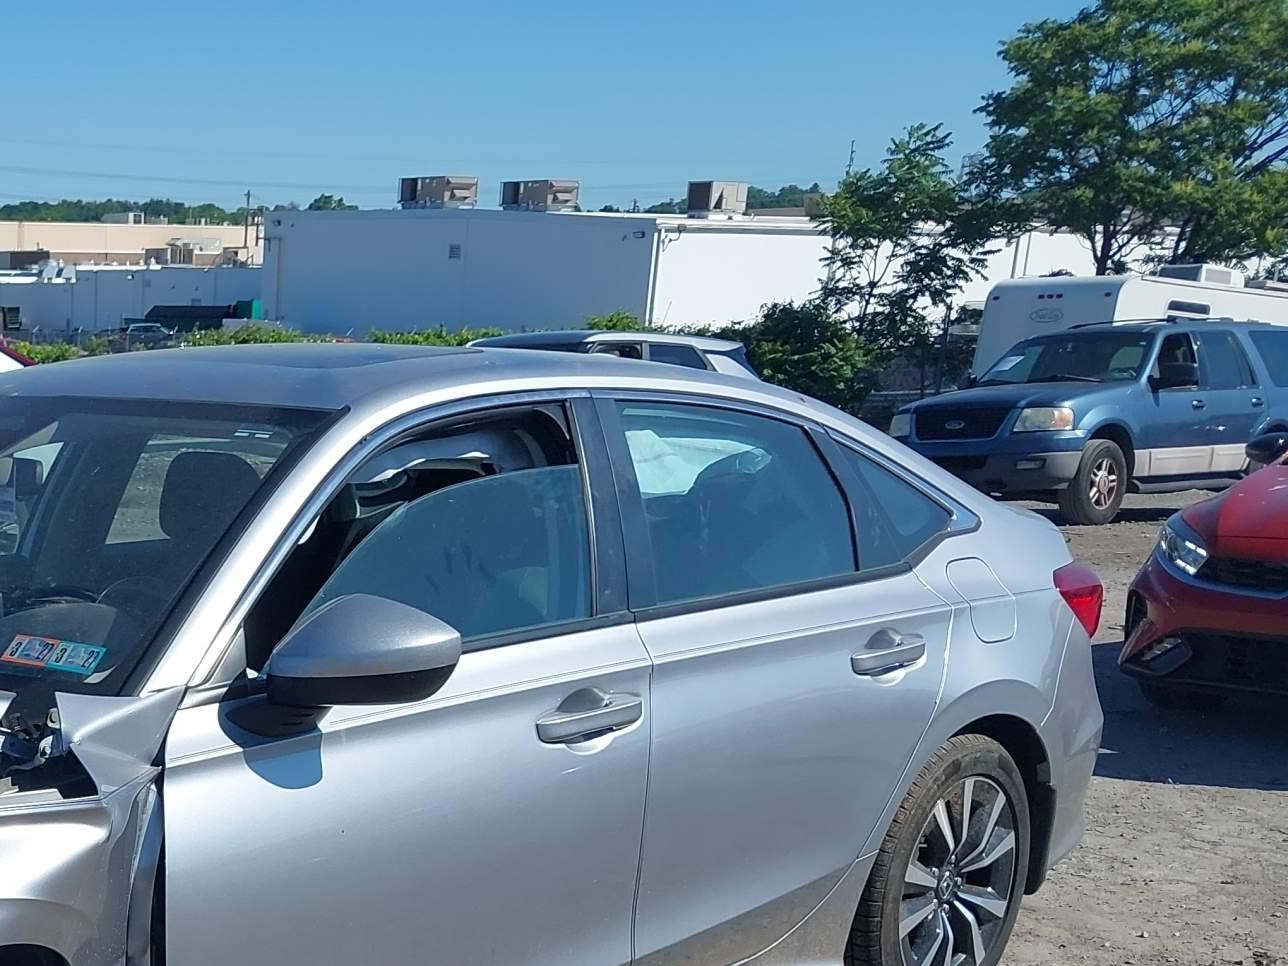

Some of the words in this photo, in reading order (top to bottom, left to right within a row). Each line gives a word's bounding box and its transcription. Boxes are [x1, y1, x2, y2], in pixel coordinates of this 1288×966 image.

[10, 642, 22, 656] 3
[55, 648, 67, 663] 3
[81, 650, 100, 668] 27
